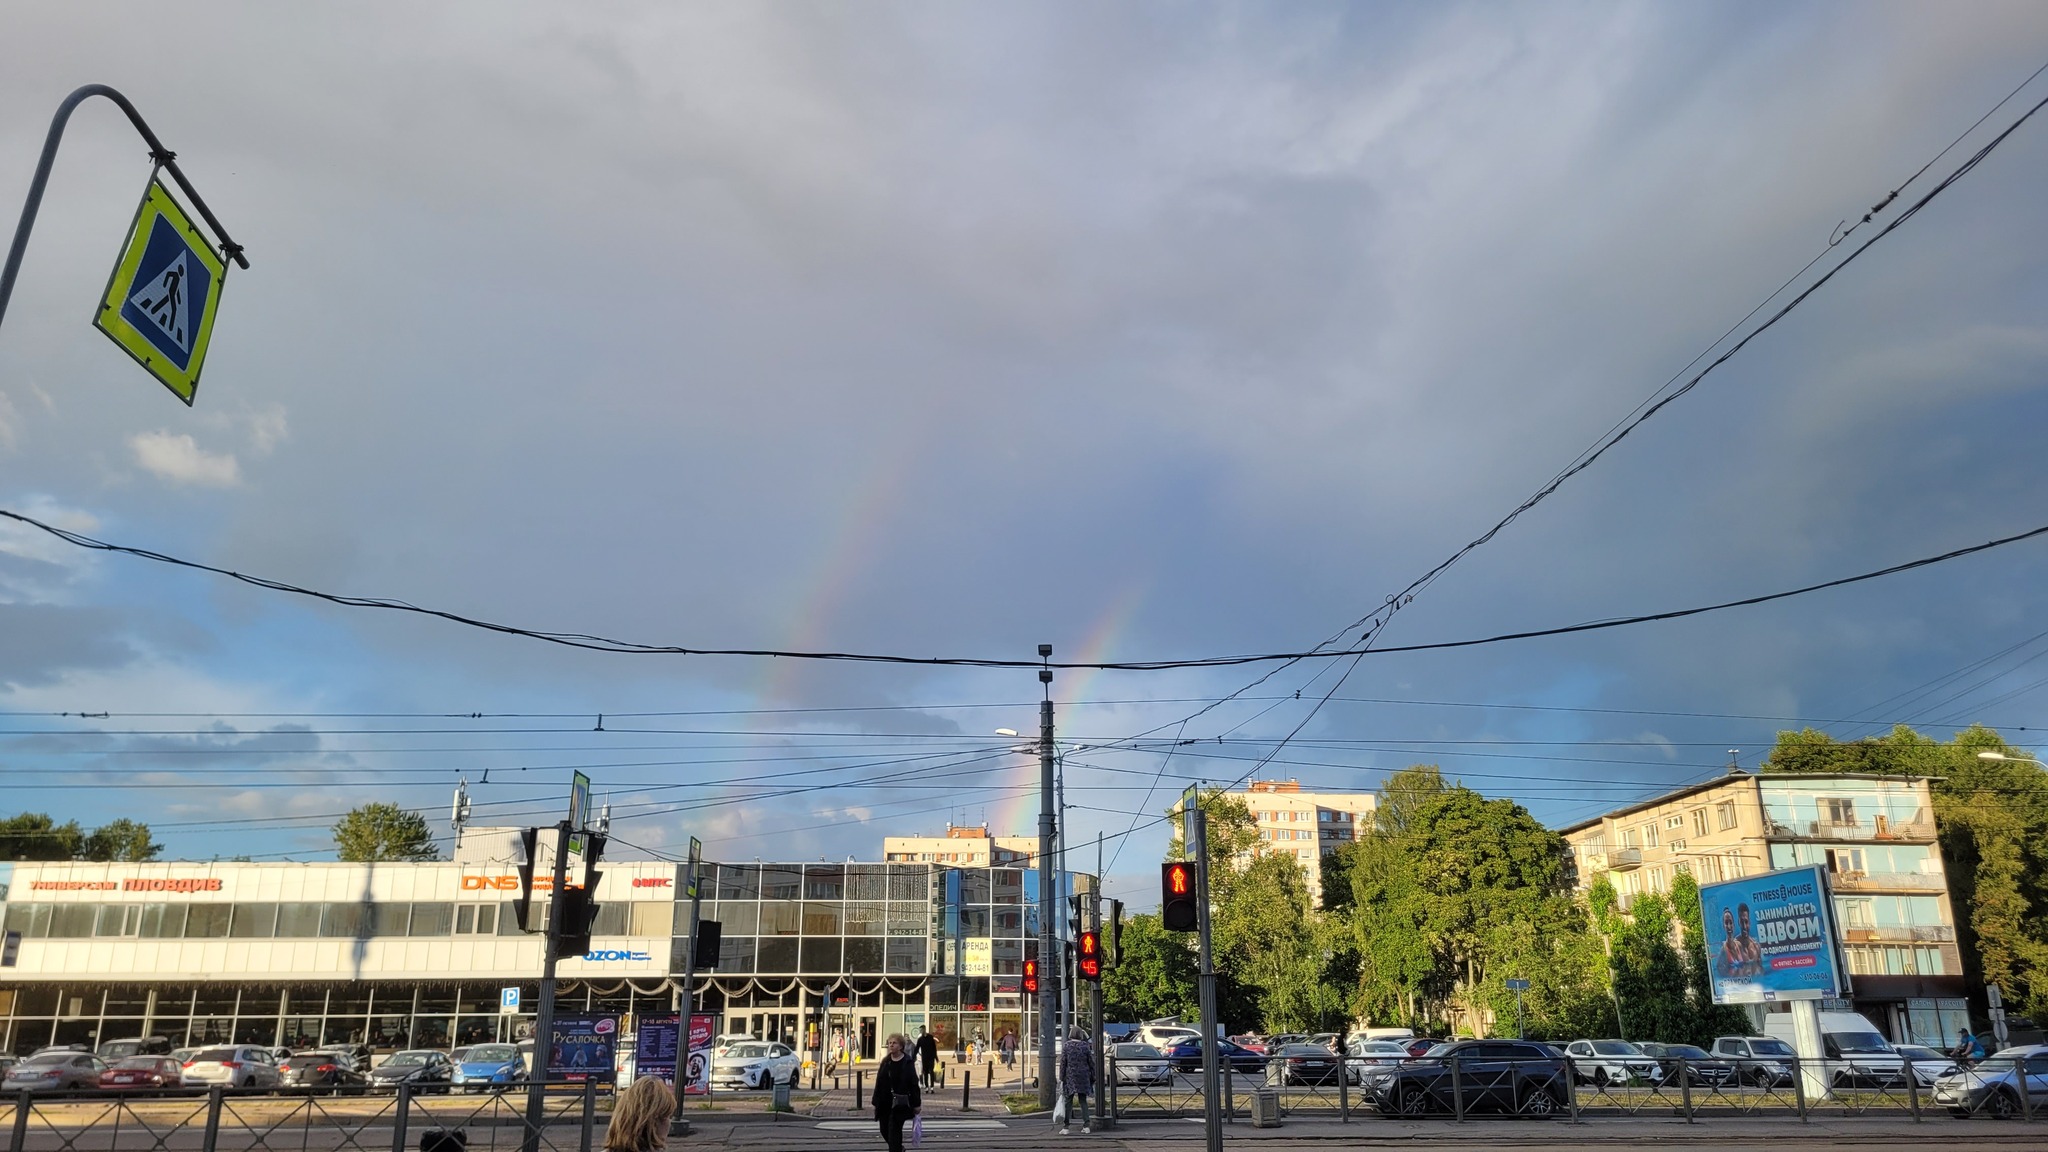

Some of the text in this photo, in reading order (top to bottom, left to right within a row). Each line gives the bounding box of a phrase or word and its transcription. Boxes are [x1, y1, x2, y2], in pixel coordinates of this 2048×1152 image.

[30, 878, 223, 893] УНИВЕРСАМ ПЛОВДИВ
[461, 876, 519, 890] DNS
[1752, 883, 1813, 903] FITNESS HOUSE
[1754, 902, 1816, 921] ЗАНИМАЙТЕСЬ
[1756, 916, 1821, 945] ВДВОЕМ
[961, 942, 989, 951] АРЕНДА
[1768, 945, 1789, 955] ОДНОМУ
[1789, 941, 1823, 952] АБОНЕМЕНТУ
[583, 950, 632, 961] OZON
[961, 963, 989, 972] 942-14-81
[1082, 961, 1097, 974] 45
[1025, 980, 1036, 990] 45
